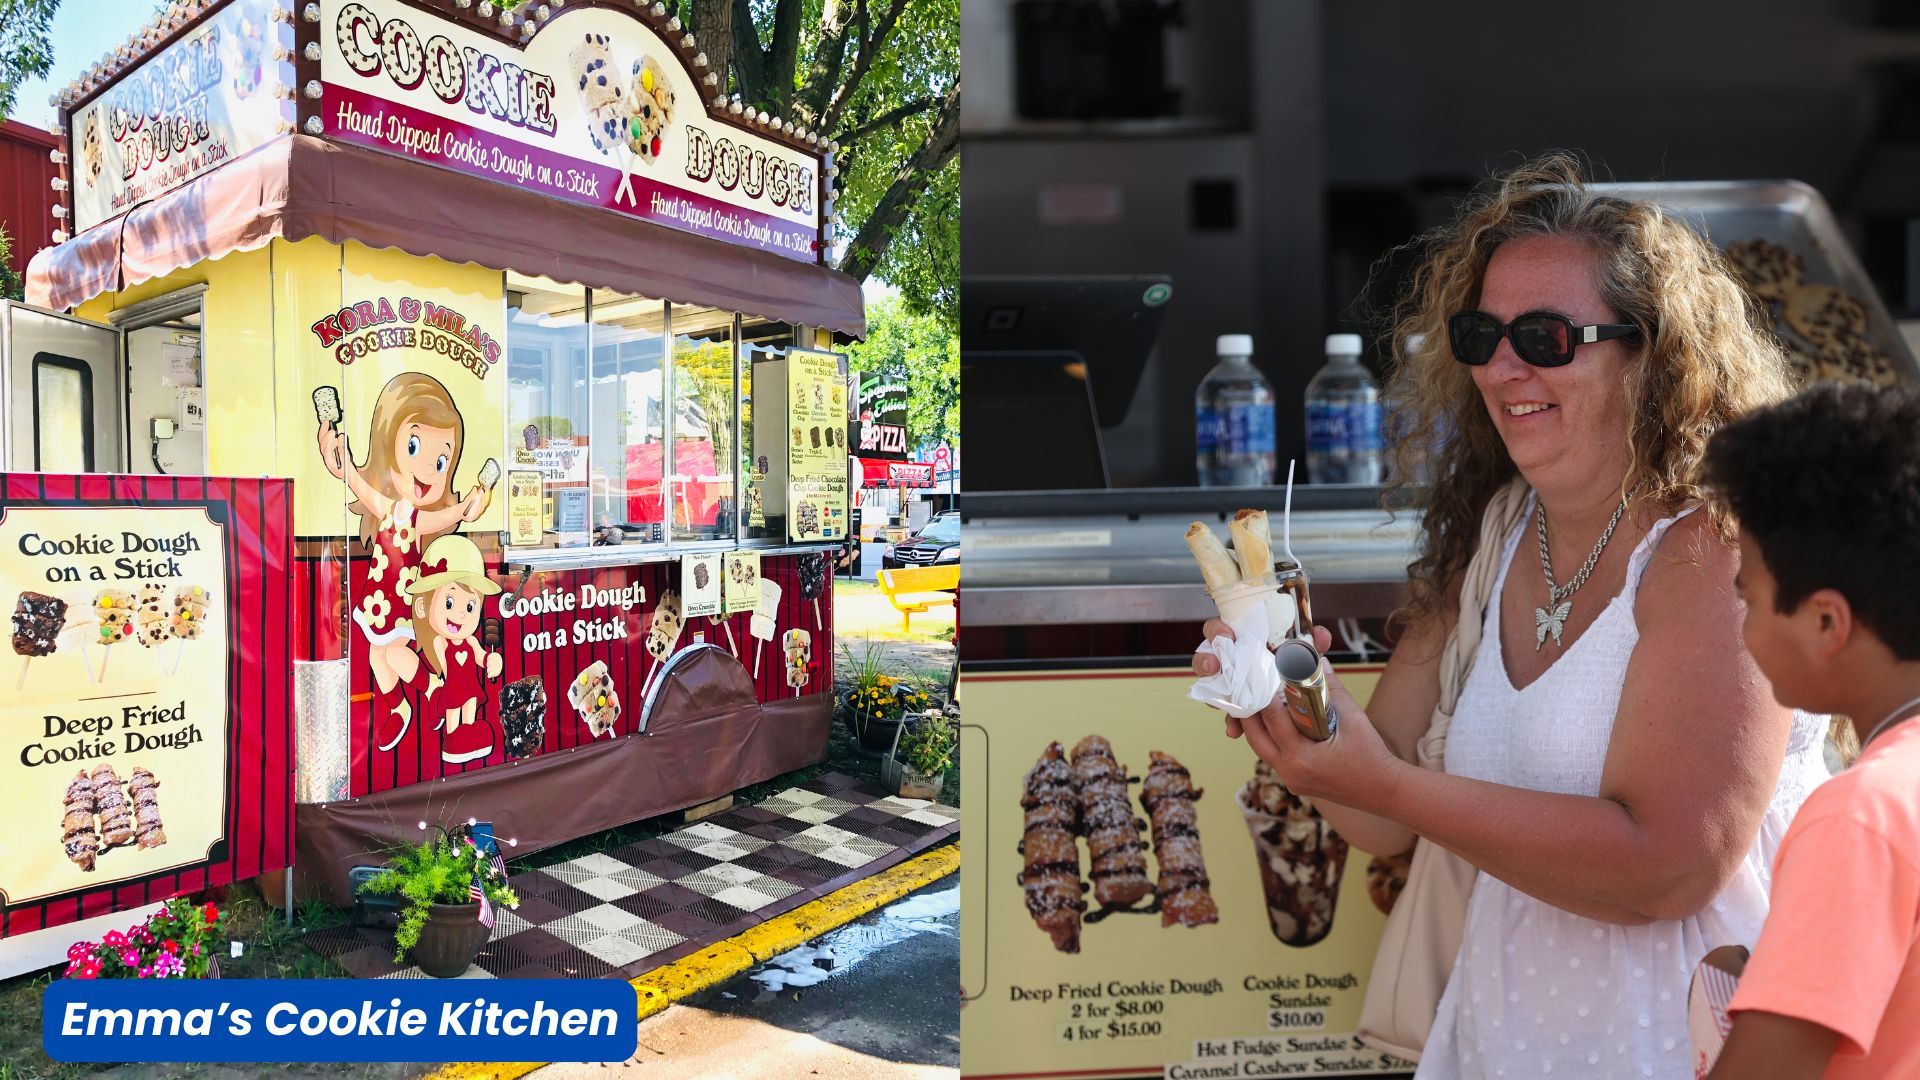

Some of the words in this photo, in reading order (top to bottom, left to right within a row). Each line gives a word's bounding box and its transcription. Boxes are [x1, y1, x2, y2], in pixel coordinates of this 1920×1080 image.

[110, 24, 223, 143] COOKIE
[337, 3, 557, 138] COOKIE
[122, 96, 210, 181] DOUGH
[337, 101, 384, 139] Hand
[386, 114, 442, 155] Dipped
[443, 131, 489, 169] Cookie
[491, 145, 534, 184] Dough
[536, 171, 553, 186] on
[554, 175, 565, 189] a
[566, 169, 600, 200] Stick
[111, 189, 126, 212] Hand
[127, 182, 147, 206] Dipped
[149, 171, 168, 194] Cookie
[168, 160, 190, 184] Dough
[191, 157, 200, 172] on
[201, 154, 208, 165] a
[207, 136, 229, 165] Stick
[685, 124, 813, 216] DOUGH
[650, 191, 679, 218] Hand
[679, 199, 713, 230] Dipped
[713, 209, 743, 238] Cookie
[742, 217, 772, 247] Dough
[773, 230, 784, 246] on
[784, 235, 791, 248] a
[791, 232, 813, 256] Stick
[311, 296, 398, 348] KORA
[398, 296, 422, 324] &
[423, 301, 501, 364] MILA'S
[335, 327, 417, 366] COOKIE
[420, 329, 490, 381] DOUGH
[870, 424, 907, 453] PIZZA
[897, 467, 923, 480] PIZZA
[18, 531, 116, 557] Cookie
[121, 530, 201, 556] Dough
[45, 565, 82, 583] on
[89, 564, 107, 581] a
[113, 556, 183, 580] Stick
[498, 587, 576, 619] Cookie
[580, 580, 647, 611] Dough
[523, 630, 552, 653] on
[554, 628, 568, 648] a
[572, 615, 628, 645] Stick
[43, 713, 113, 742] Deep
[121, 700, 187, 729] Fried
[20, 733, 117, 767] Cookie
[124, 724, 204, 755] Dough
[1010, 986, 1053, 1003] Deep
[1057, 982, 1103, 999] Fried
[1106, 980, 1165, 998] Cookie
[1169, 977, 1224, 996] Dough
[1242, 975, 1300, 992] Cookie
[1305, 972, 1359, 990] Dough
[1268, 993, 1332, 1009] Sundae
[1071, 1004, 1082, 1019] 2
[1087, 1002, 1110, 1018] for
[1114, 1000, 1164, 1018] $8.00
[1269, 1010, 1325, 1028] $10.00
[1062, 1026, 1074, 1041] 4
[1079, 1025, 1102, 1041] for
[1106, 1020, 1162, 1038] $15.00
[1196, 1041, 1227, 1058] Hot
[1231, 1039, 1282, 1058] Fudge
[1286, 1036, 1347, 1053] Sundae
[1169, 1062, 1239, 1080] Caramel
[1243, 1058, 1307, 1078] Cashew
[1312, 1055, 1373, 1073] Sundae
